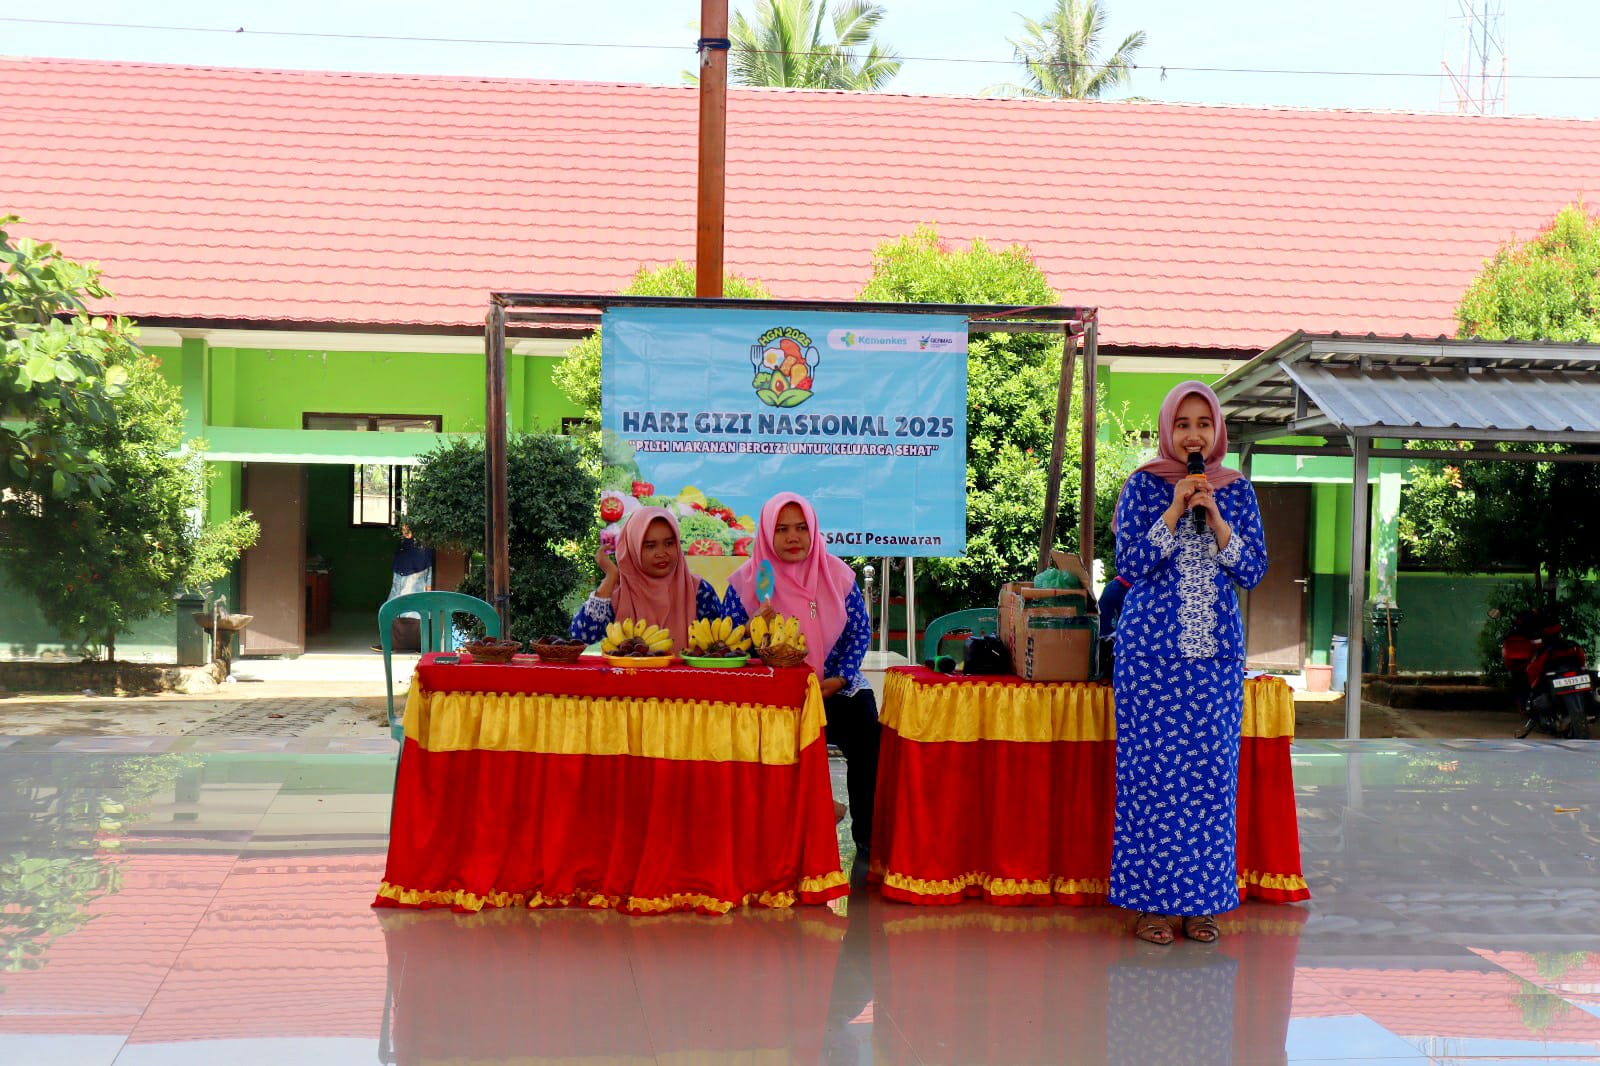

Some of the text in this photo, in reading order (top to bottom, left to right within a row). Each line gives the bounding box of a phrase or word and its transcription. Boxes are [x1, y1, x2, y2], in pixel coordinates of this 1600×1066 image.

[758, 327, 812, 348] HGN 2025
[858, 335, 907, 345] Kemenkes
[622, 411, 954, 438] HARI GIZI NASIONAL 2025
[629, 440, 939, 456] "PILIH MAKANAN BERGIZI UNTUK KELUARGA SEHAT"
[821, 532, 941, 545] SAGI Pesawaran
